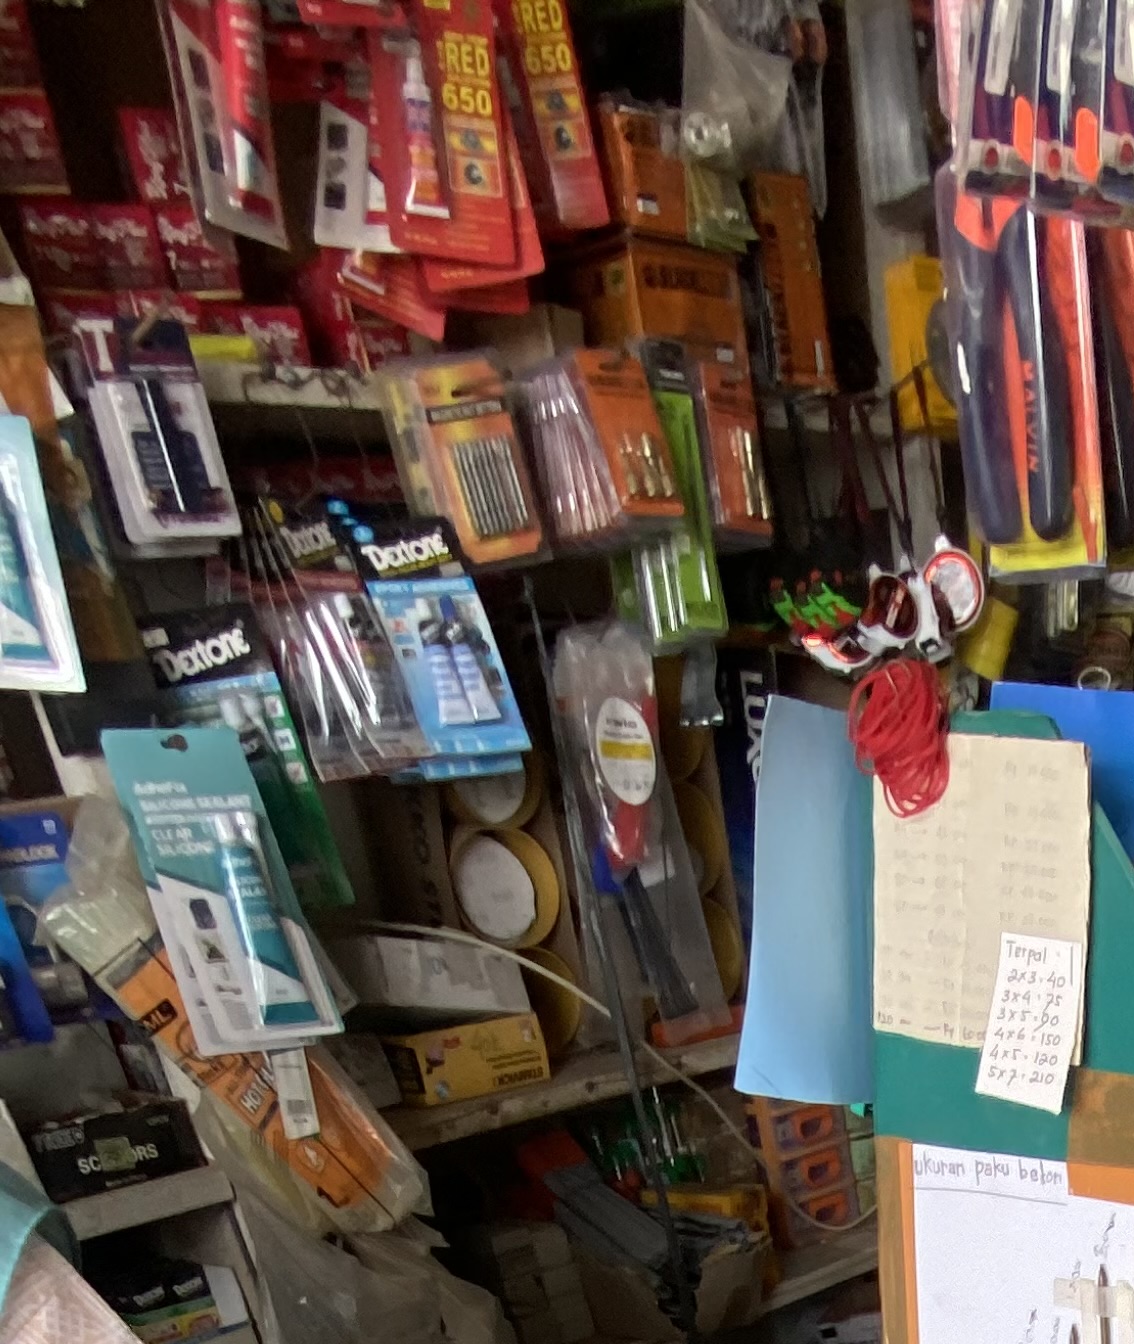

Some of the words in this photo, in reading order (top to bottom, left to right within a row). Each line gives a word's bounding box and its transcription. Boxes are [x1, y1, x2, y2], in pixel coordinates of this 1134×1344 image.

[520, 0, 563, 34] RED
[445, 41, 490, 78] RED
[524, 42, 572, 76] 650
[442, 82, 492, 116] 650
[361, 527, 449, 572] Dextone
[153, 620, 250, 683] Dextone
[1006, 940, 1047, 966] Terpal
[914, 1151, 965, 1177] ukuran
[974, 1155, 1010, 1186] paku
